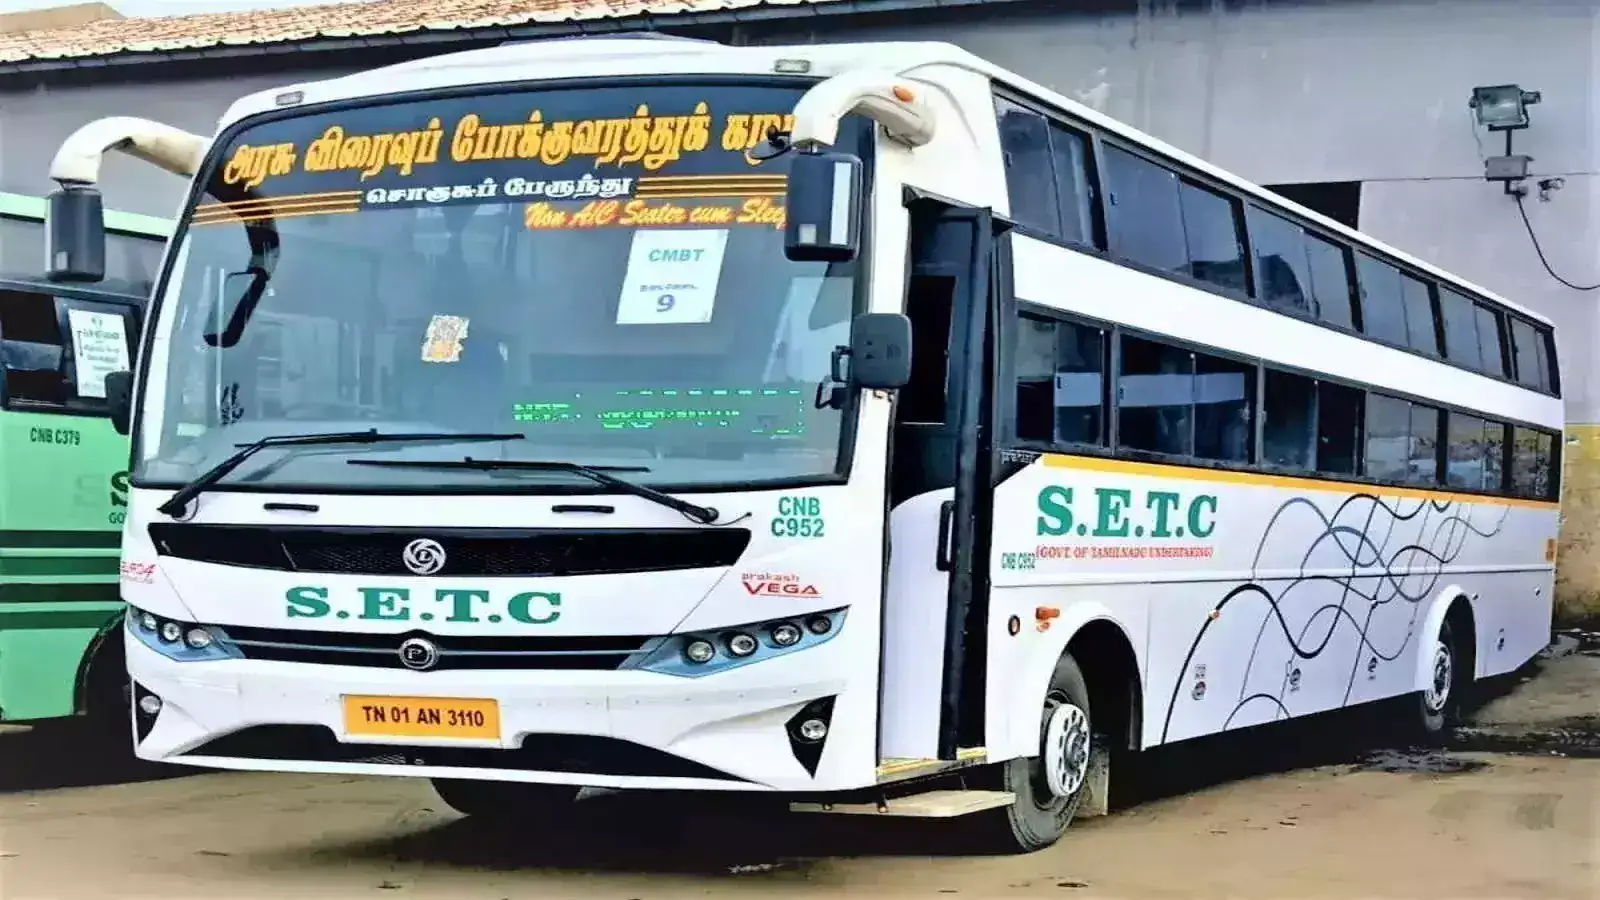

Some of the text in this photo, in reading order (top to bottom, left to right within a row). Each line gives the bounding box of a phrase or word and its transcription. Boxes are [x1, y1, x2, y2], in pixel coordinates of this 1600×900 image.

[222, 143, 297, 192] அரசு
[451, 102, 711, 170] போக்குவரத்துக்
[504, 173, 634, 199] பேருந்து
[524, 201, 566, 228] Non
[648, 248, 704, 262] CMBT
[656, 294, 676, 312] 9
[30, 427, 80, 446] CNB C379
[779, 496, 820, 516] CNB
[1037, 485, 1217, 538] S.E.T.C
[771, 517, 825, 537] C952
[743, 581, 820, 596] VEGA
[286, 586, 561, 624] S.E.T.C
[362, 705, 485, 727] TN 01 AN 3110
